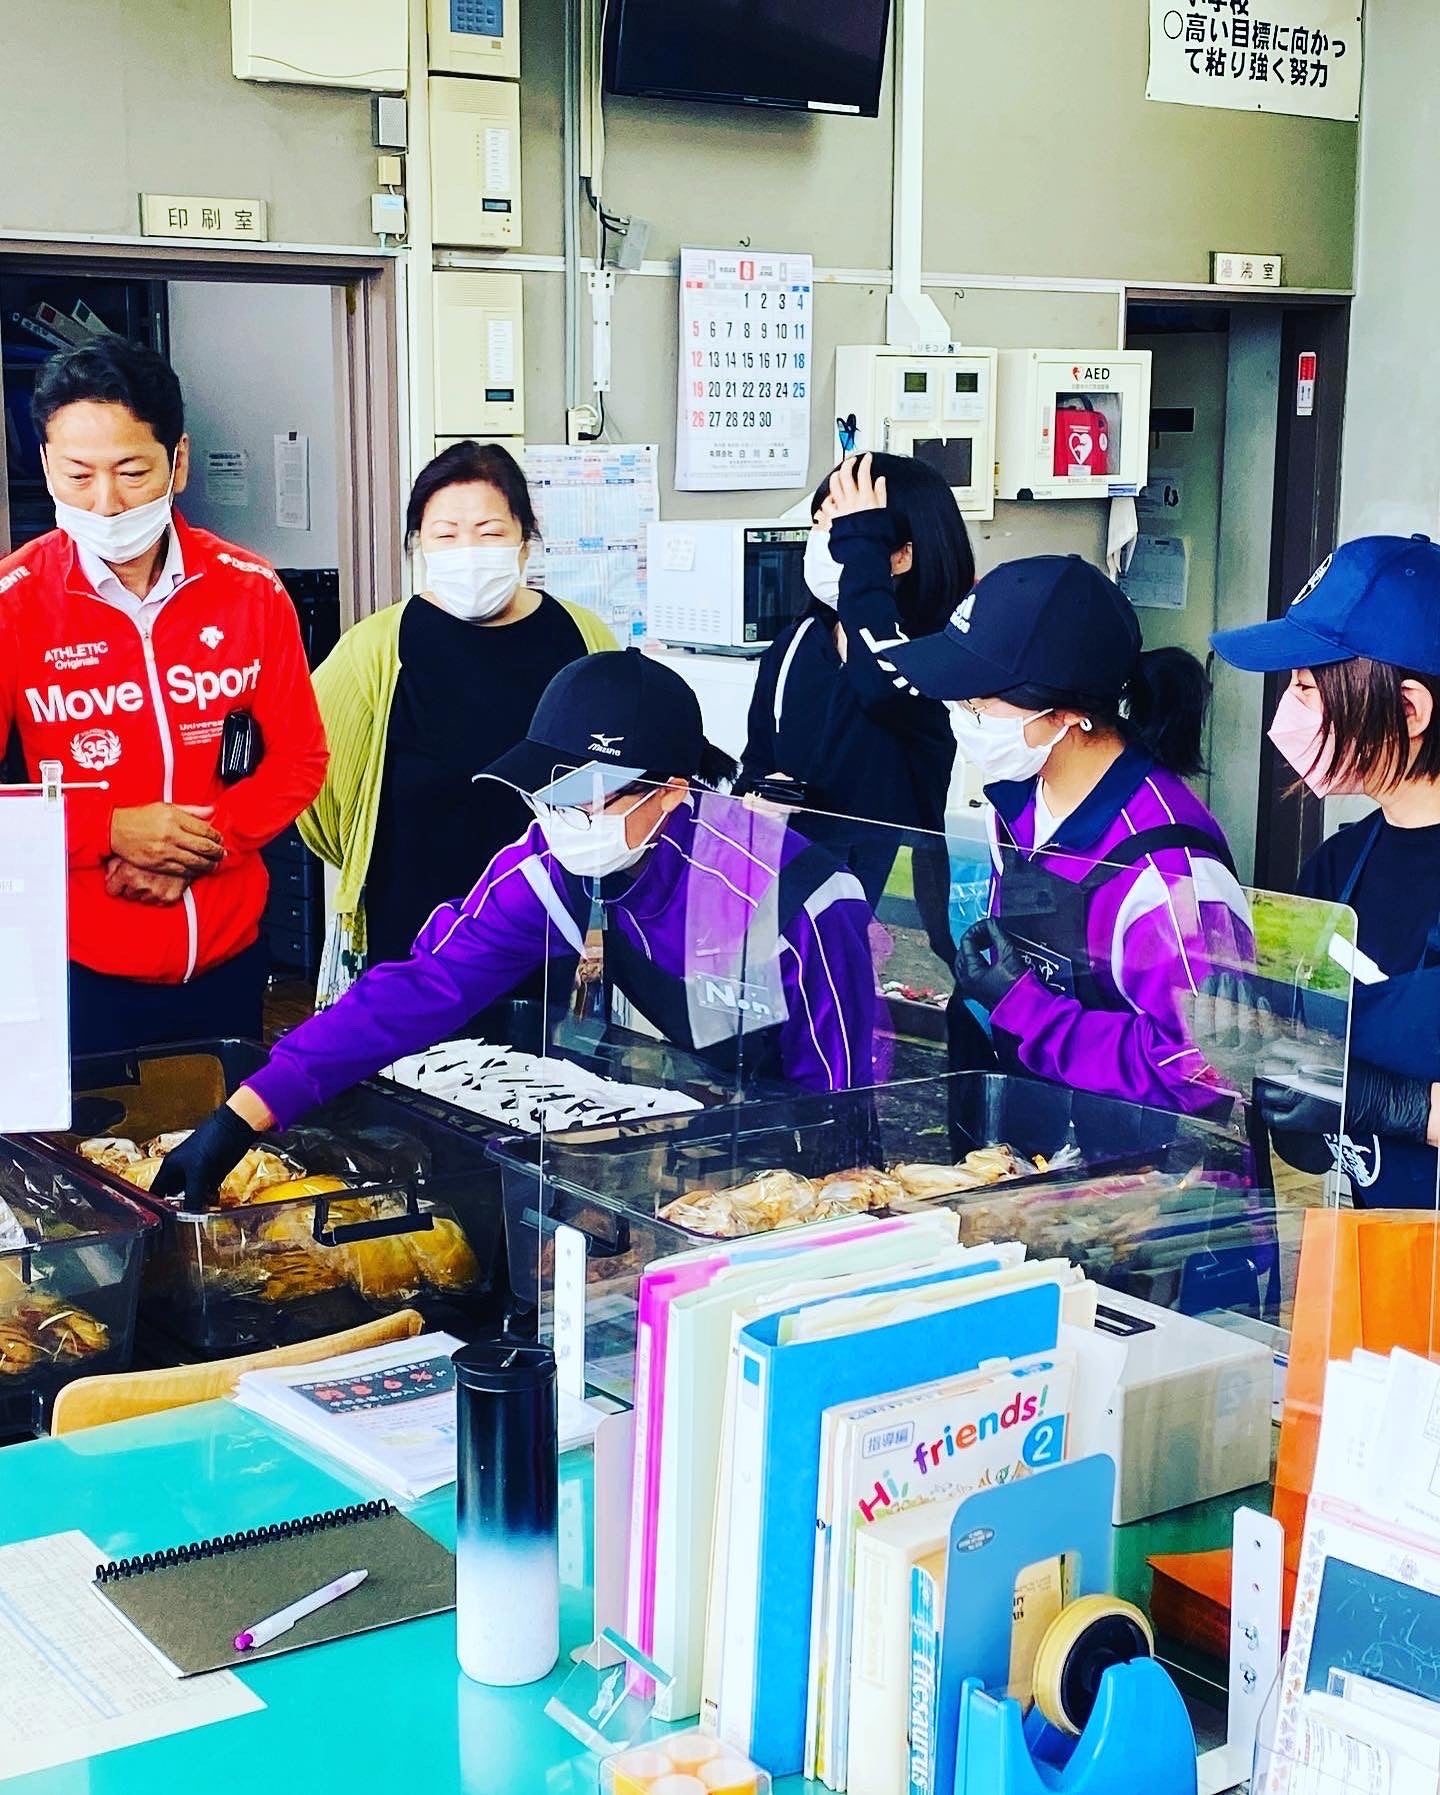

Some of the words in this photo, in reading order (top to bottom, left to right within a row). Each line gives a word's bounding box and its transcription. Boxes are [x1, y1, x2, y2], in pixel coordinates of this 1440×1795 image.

[1185, 47, 1328, 88] て粘り強く努力
[168, 207, 254, 231] 印刷室
[744, 292, 749, 308] 1
[761, 293, 767, 309] 2
[779, 294, 786, 309] 3
[797, 295, 803, 310] 4
[693, 321, 699, 336] 5
[710, 321, 716, 337] 6
[726, 322, 732, 337] 7
[744, 323, 750, 338] 8
[761, 323, 767, 339] 9
[776, 323, 787, 339] 10
[794, 324, 804, 340] 11
[692, 351, 702, 367] 12
[709, 352, 719, 368] 13
[725, 352, 736, 368] 14
[742, 352, 753, 369] 15
[759, 353, 770, 369] 16
[776, 353, 787, 369] 17
[794, 353, 805, 369] 18
[1085, 368, 1110, 380] AED
[694, 381, 703, 397] 19
[709, 382, 720, 398] 20
[726, 382, 736, 398] 21
[742, 382, 754, 398] 22
[759, 382, 771, 398] 23
[776, 382, 788, 398] 24
[793, 383, 805, 398] 25
[692, 411, 704, 427] 26
[709, 411, 720, 427] 27
[726, 412, 738, 427] 28
[742, 412, 755, 427] 29
[759, 412, 771, 427] 30
[44, 641, 109, 662] ATHLETIC
[55, 656, 100, 670] Originals
[25, 680, 144, 723] Move
[166, 658, 262, 711] Sport
[83, 740, 107, 758] 35
[1032, 1425, 1055, 1461] 2
[858, 1469, 909, 1523] Hi,
[913, 1384, 1049, 1475] friends!
[911, 1652, 936, 1791] Thesaurus
